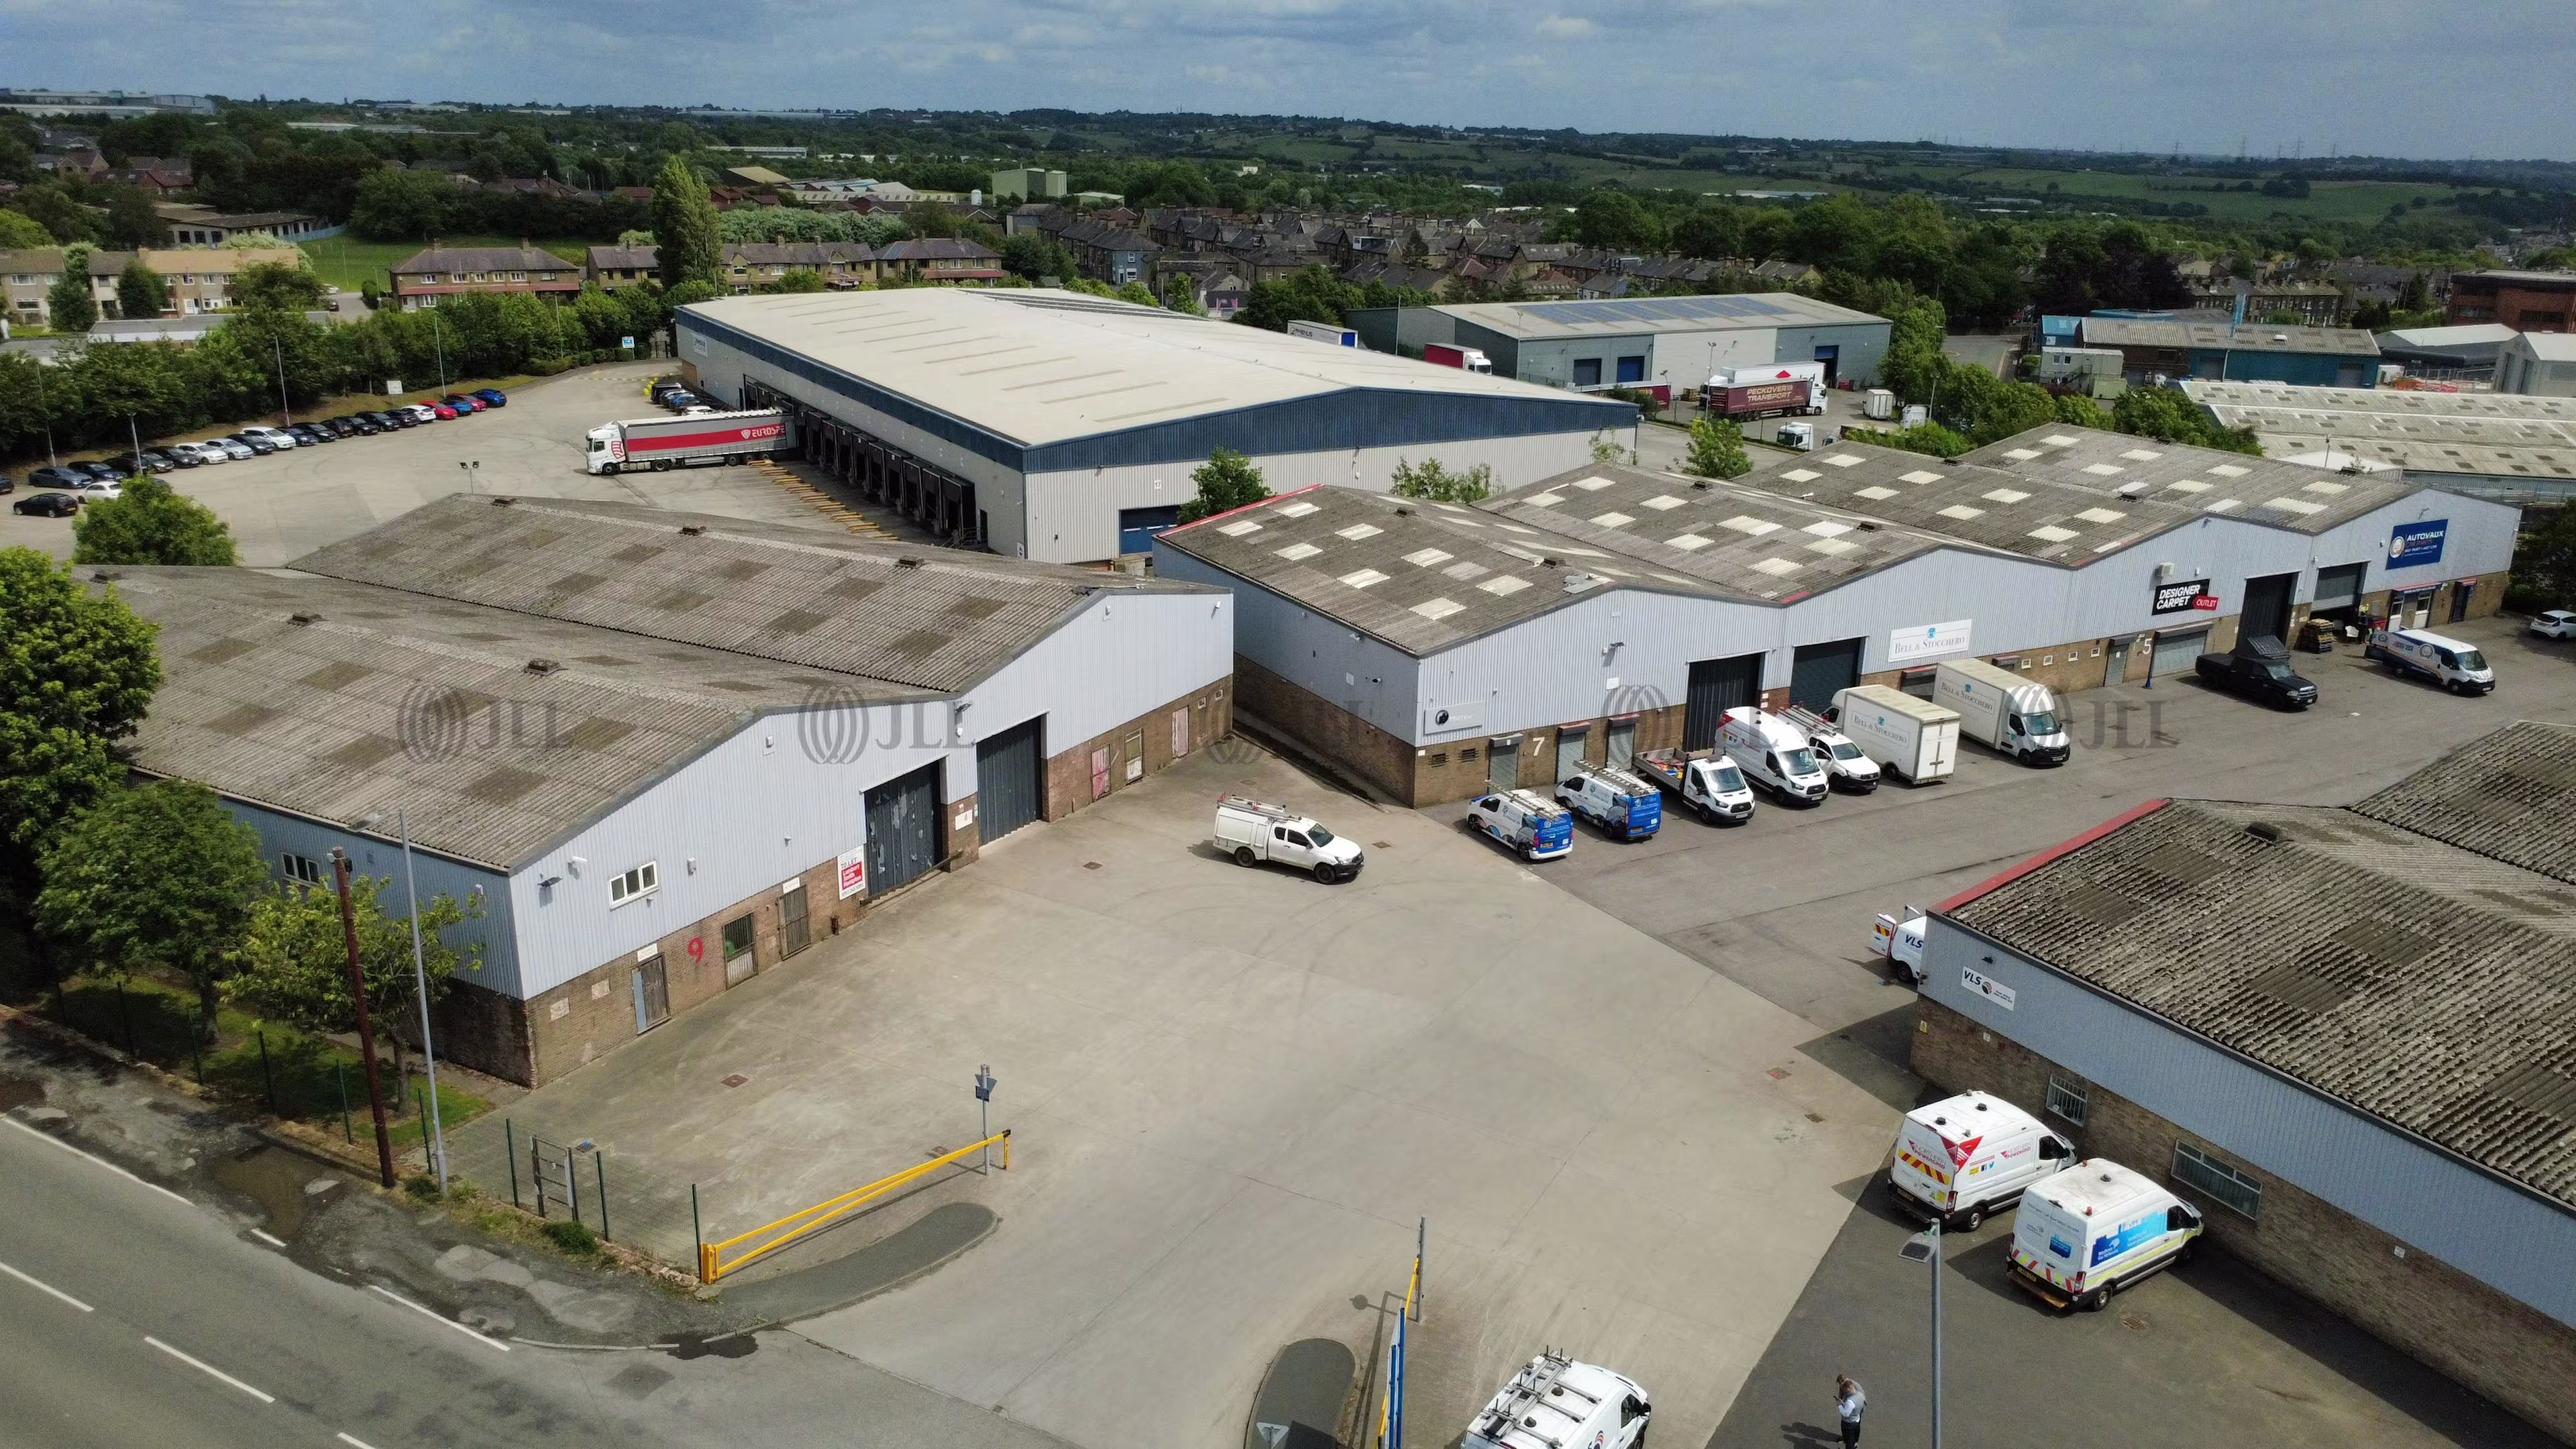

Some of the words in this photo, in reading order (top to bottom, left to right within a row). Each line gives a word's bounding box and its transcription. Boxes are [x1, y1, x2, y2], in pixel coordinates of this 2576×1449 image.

[1747, 385, 1787, 395] PECKOVER
[1748, 391, 1791, 402] TRANSPORT
[2159, 584, 2200, 600] DESIGNER
[2156, 596, 2190, 610] CARPET
[2196, 598, 2216, 607] OUTLET
[1894, 643, 1913, 654] BELL
[2143, 638, 2152, 655] 5
[1941, 681, 1954, 694] BELL
[1854, 714, 1867, 728] BELL
[1532, 737, 1545, 756] 7
[847, 857, 857, 866] LET
[1905, 934, 1924, 949] VLS
[688, 935, 704, 964] 9
[1964, 970, 1982, 985] VLS
